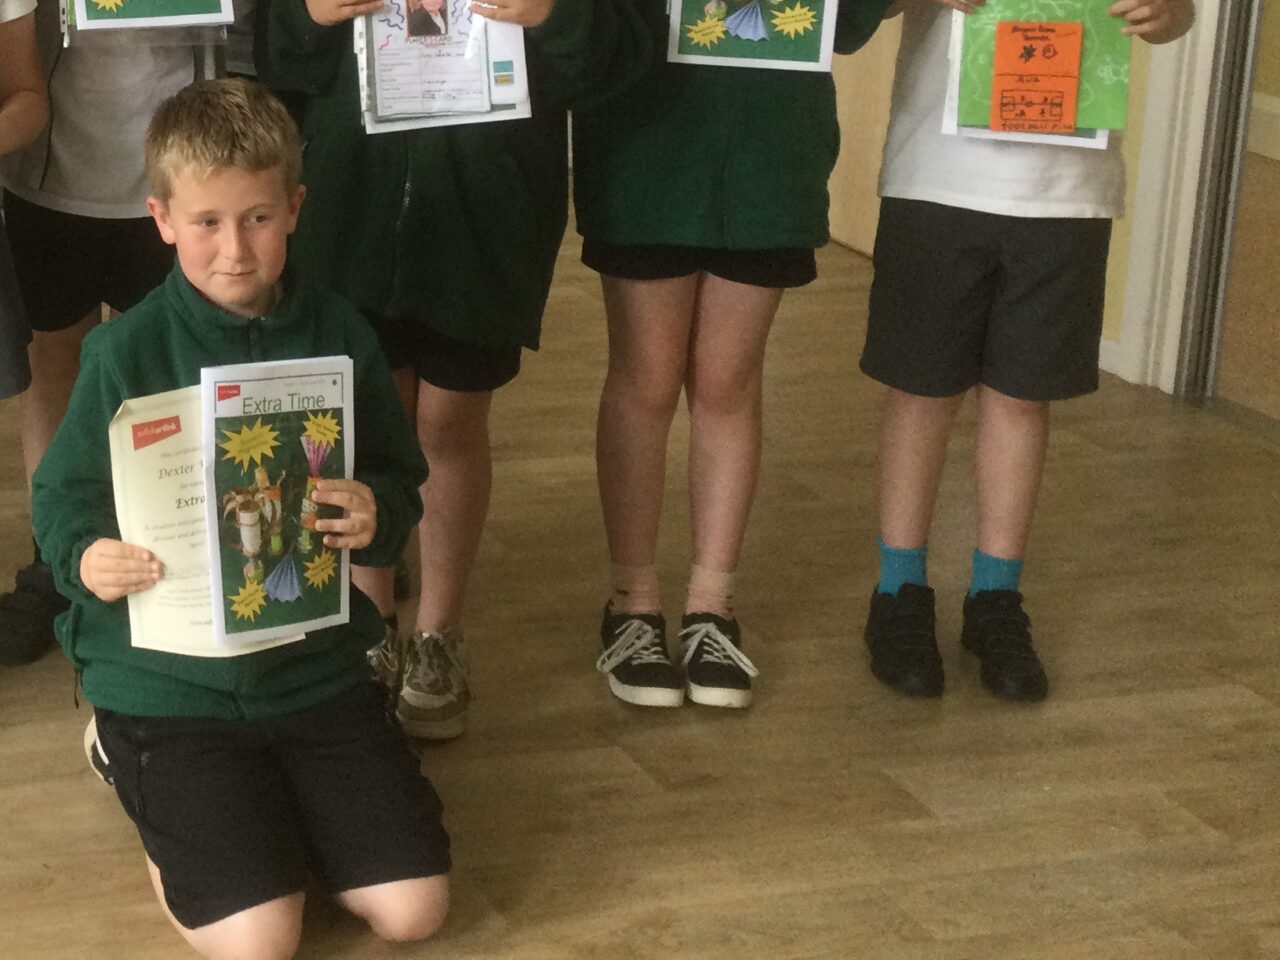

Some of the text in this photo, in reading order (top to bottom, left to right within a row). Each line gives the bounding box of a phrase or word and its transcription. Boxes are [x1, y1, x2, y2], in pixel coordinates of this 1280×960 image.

[243, 392, 326, 415] Extra Time
[157, 464, 194, 480] Dexter
